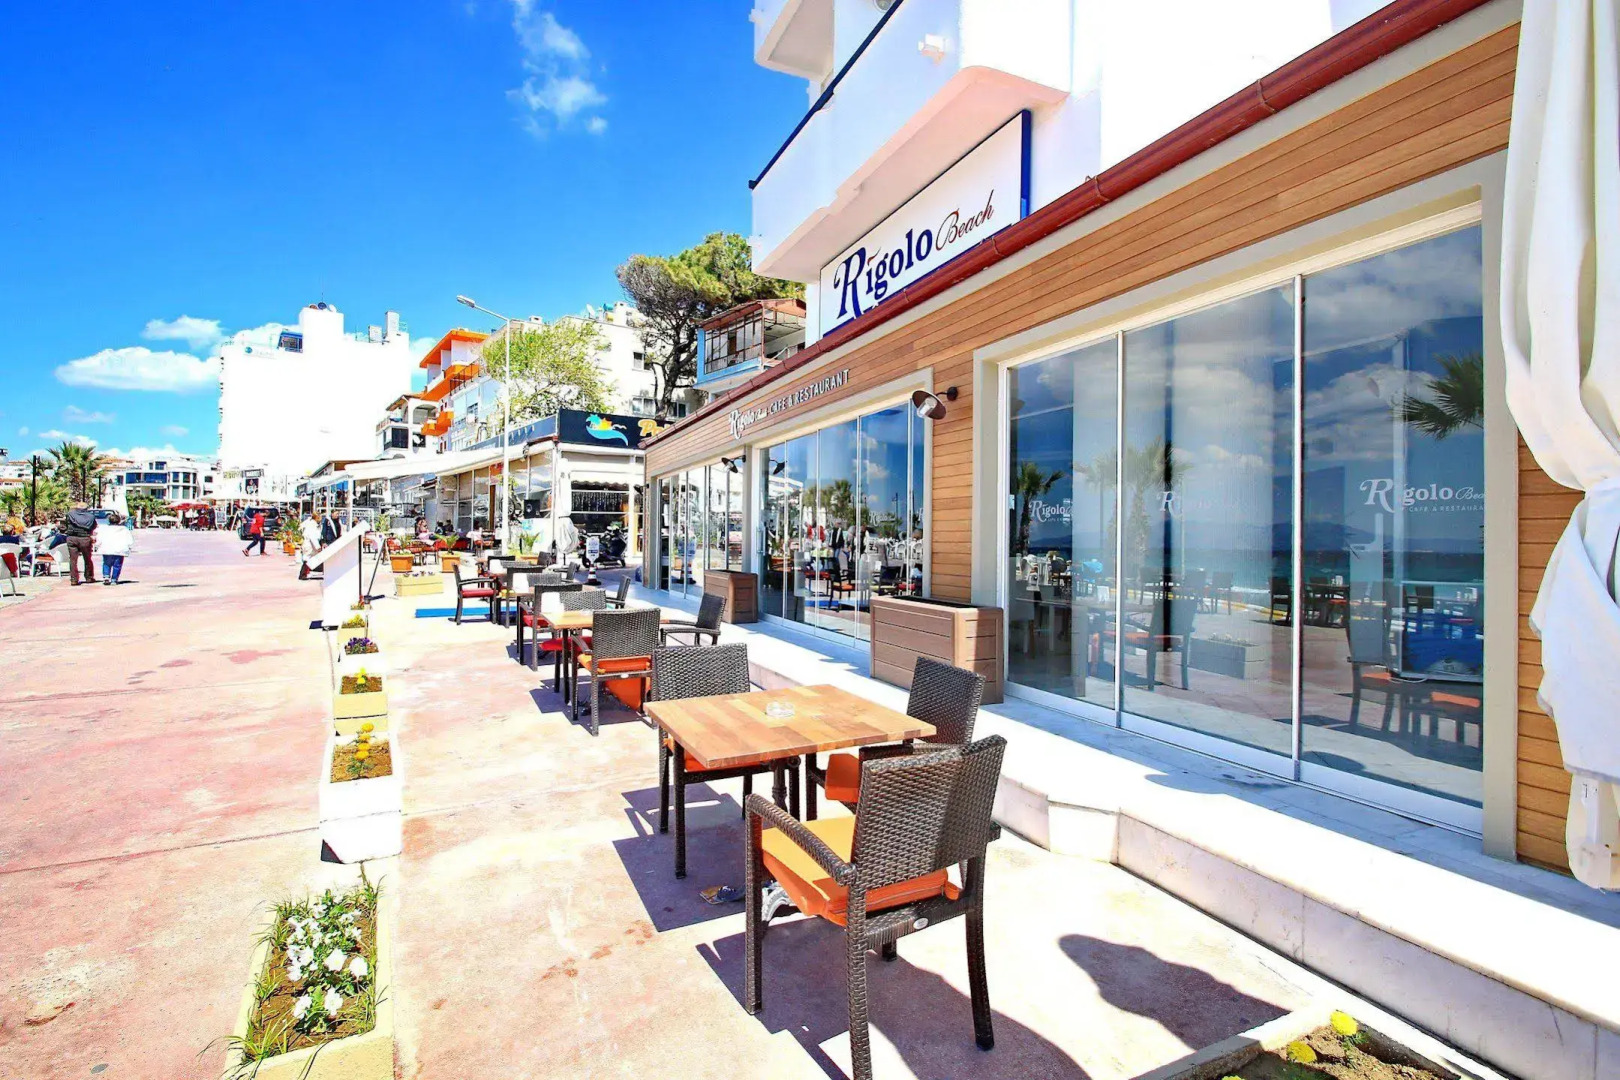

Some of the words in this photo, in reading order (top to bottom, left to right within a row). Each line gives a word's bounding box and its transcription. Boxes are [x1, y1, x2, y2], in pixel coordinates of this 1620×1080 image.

[833, 229, 933, 319] Rigolo
[935, 189, 994, 251] Beach
[794, 368, 850, 405] RESTAURANT
[1028, 500, 1065, 523] Rigolo
